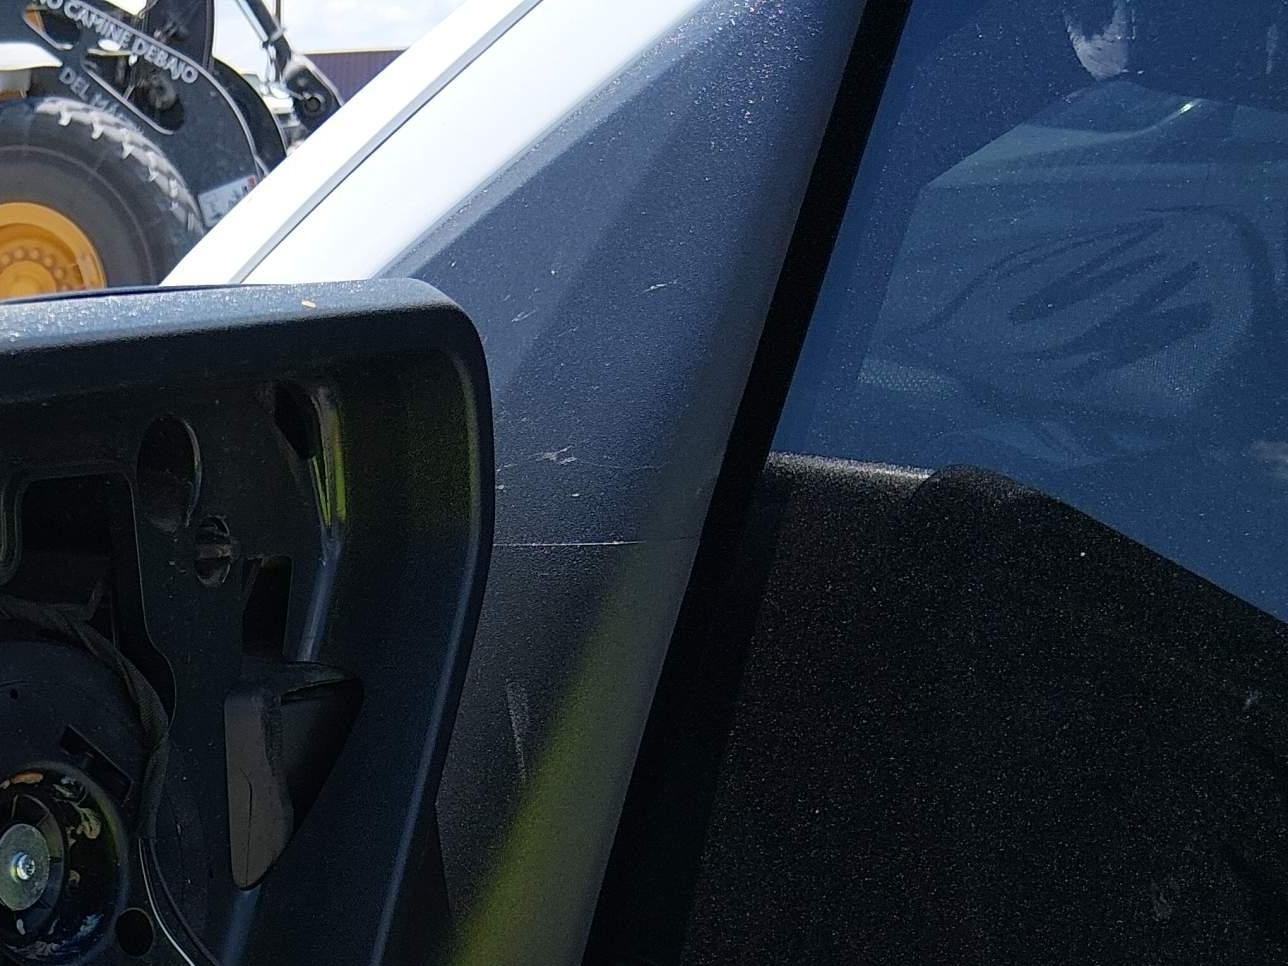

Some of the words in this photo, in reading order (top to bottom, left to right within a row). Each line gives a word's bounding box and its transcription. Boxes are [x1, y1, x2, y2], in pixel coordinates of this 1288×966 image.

[64, 1, 132, 49] CAMINE
[132, 38, 199, 84] DEBAJO
[59, 67, 90, 101] DEL
